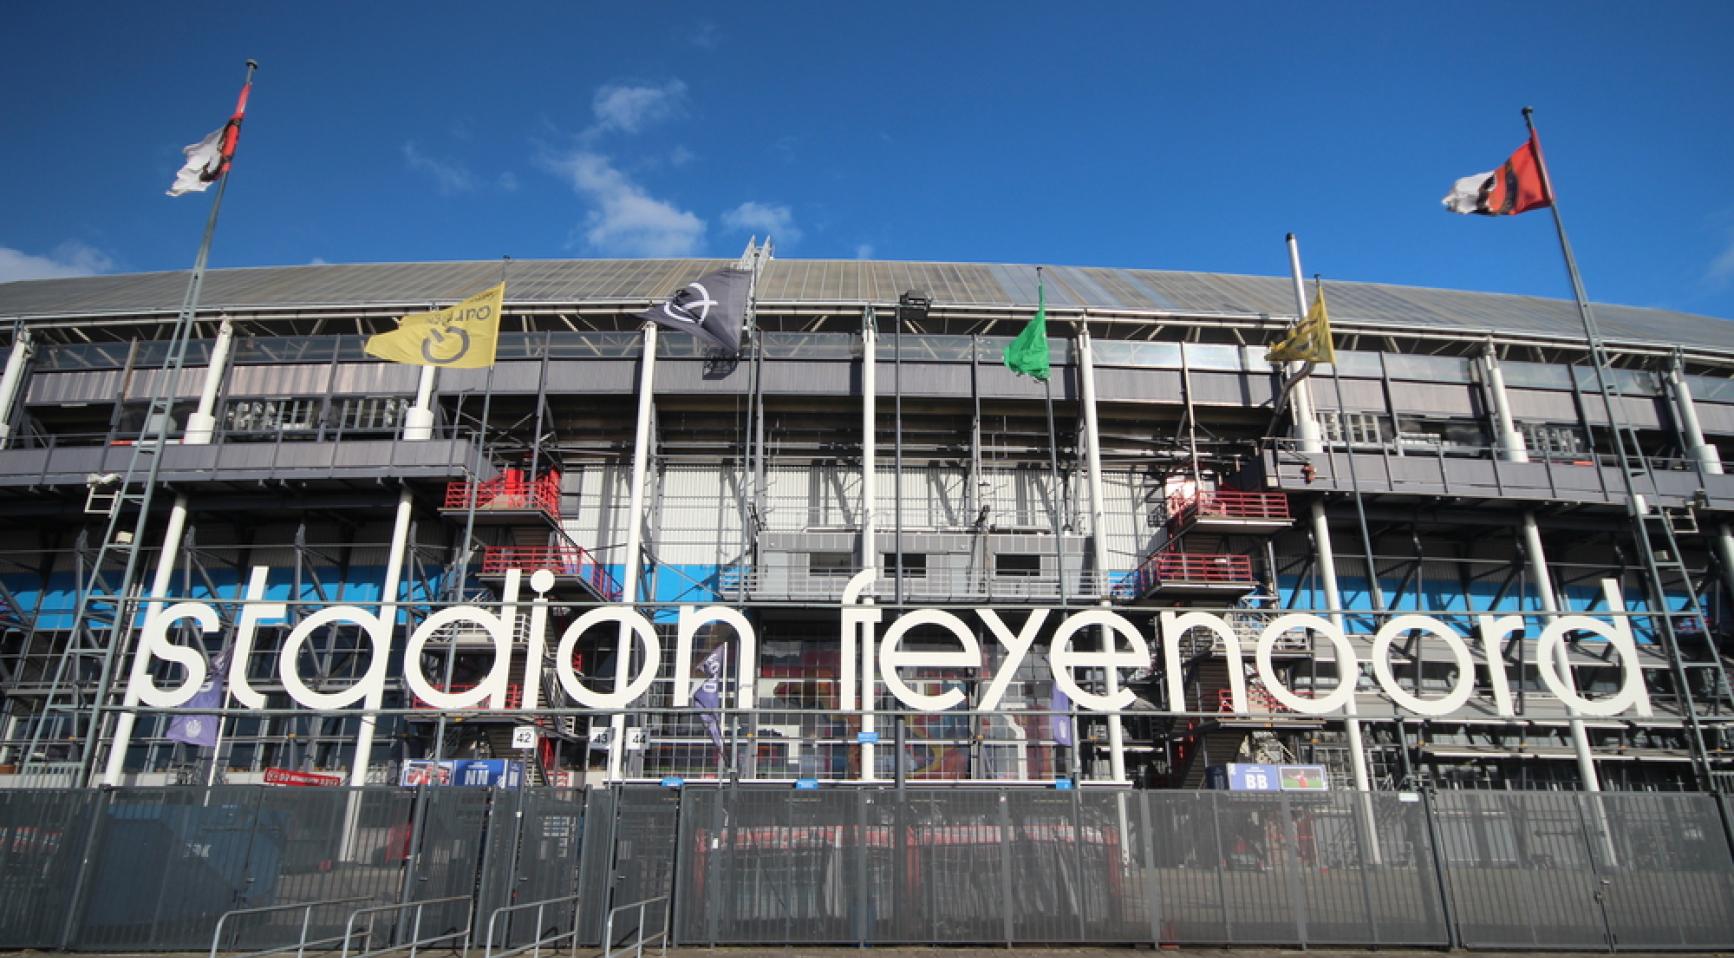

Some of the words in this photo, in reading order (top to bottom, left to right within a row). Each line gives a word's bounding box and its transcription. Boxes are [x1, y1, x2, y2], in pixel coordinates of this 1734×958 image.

[138, 565, 756, 710] stadion
[840, 567, 1654, 718] feyenoord
[516, 731, 532, 743] 42
[594, 733, 608, 744] 43
[632, 733, 646, 744] 44
[464, 769, 490, 785] NN
[1244, 773, 1269, 789] BB
